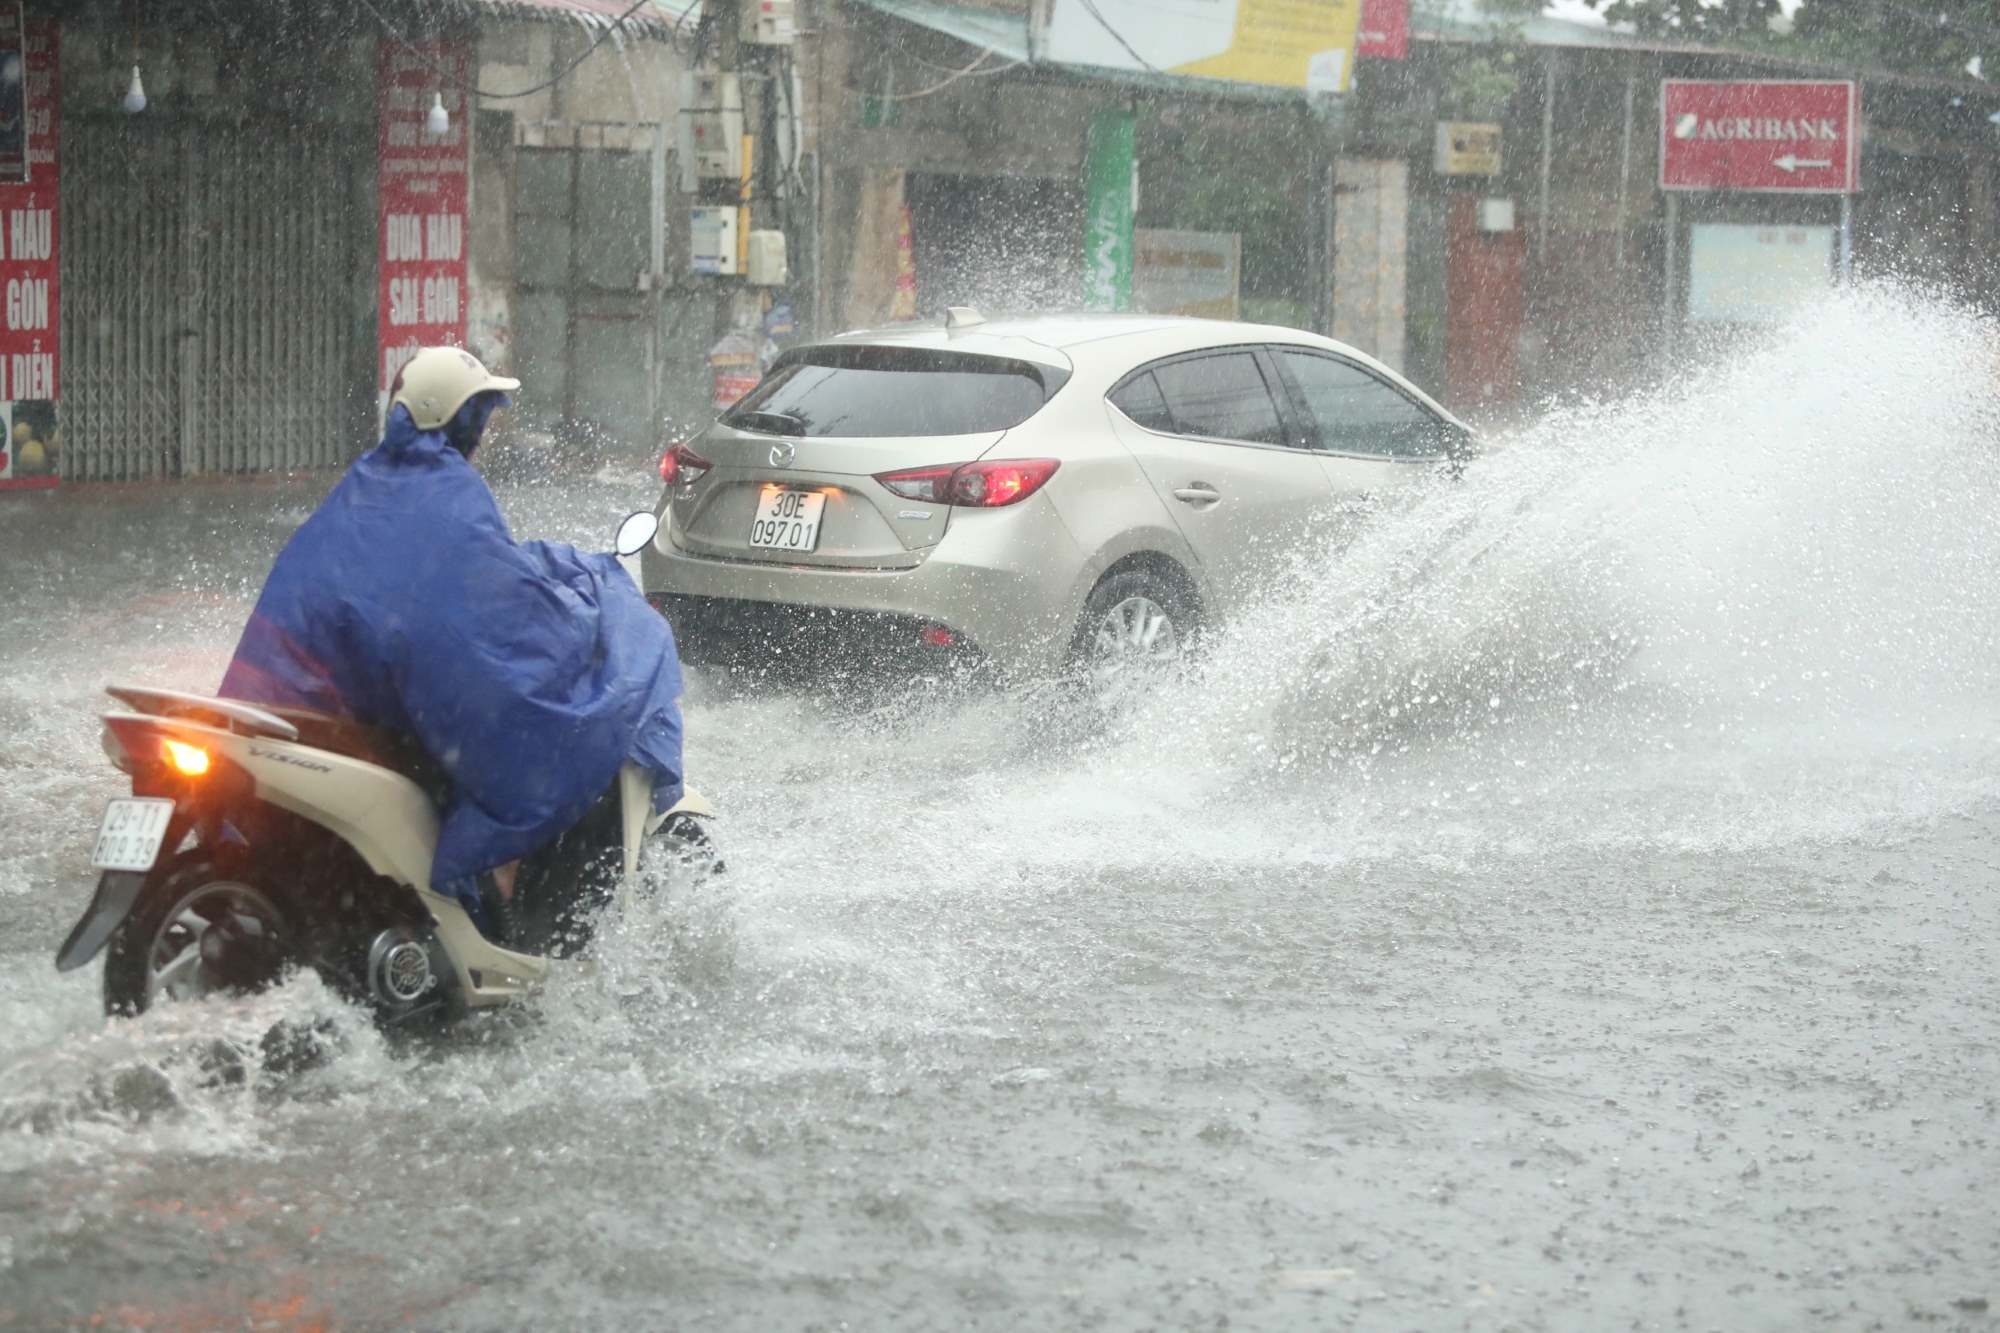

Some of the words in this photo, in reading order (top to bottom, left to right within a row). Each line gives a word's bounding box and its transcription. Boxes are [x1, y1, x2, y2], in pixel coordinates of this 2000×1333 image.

[1700, 117, 1839, 140] AGRIBANK
[11, 192, 51, 260] HẤU
[7, 270, 48, 330] GÒN
[12, 339, 53, 400] DIỄN
[771, 493, 808, 519] 30E
[752, 519, 813, 548] 097.01
